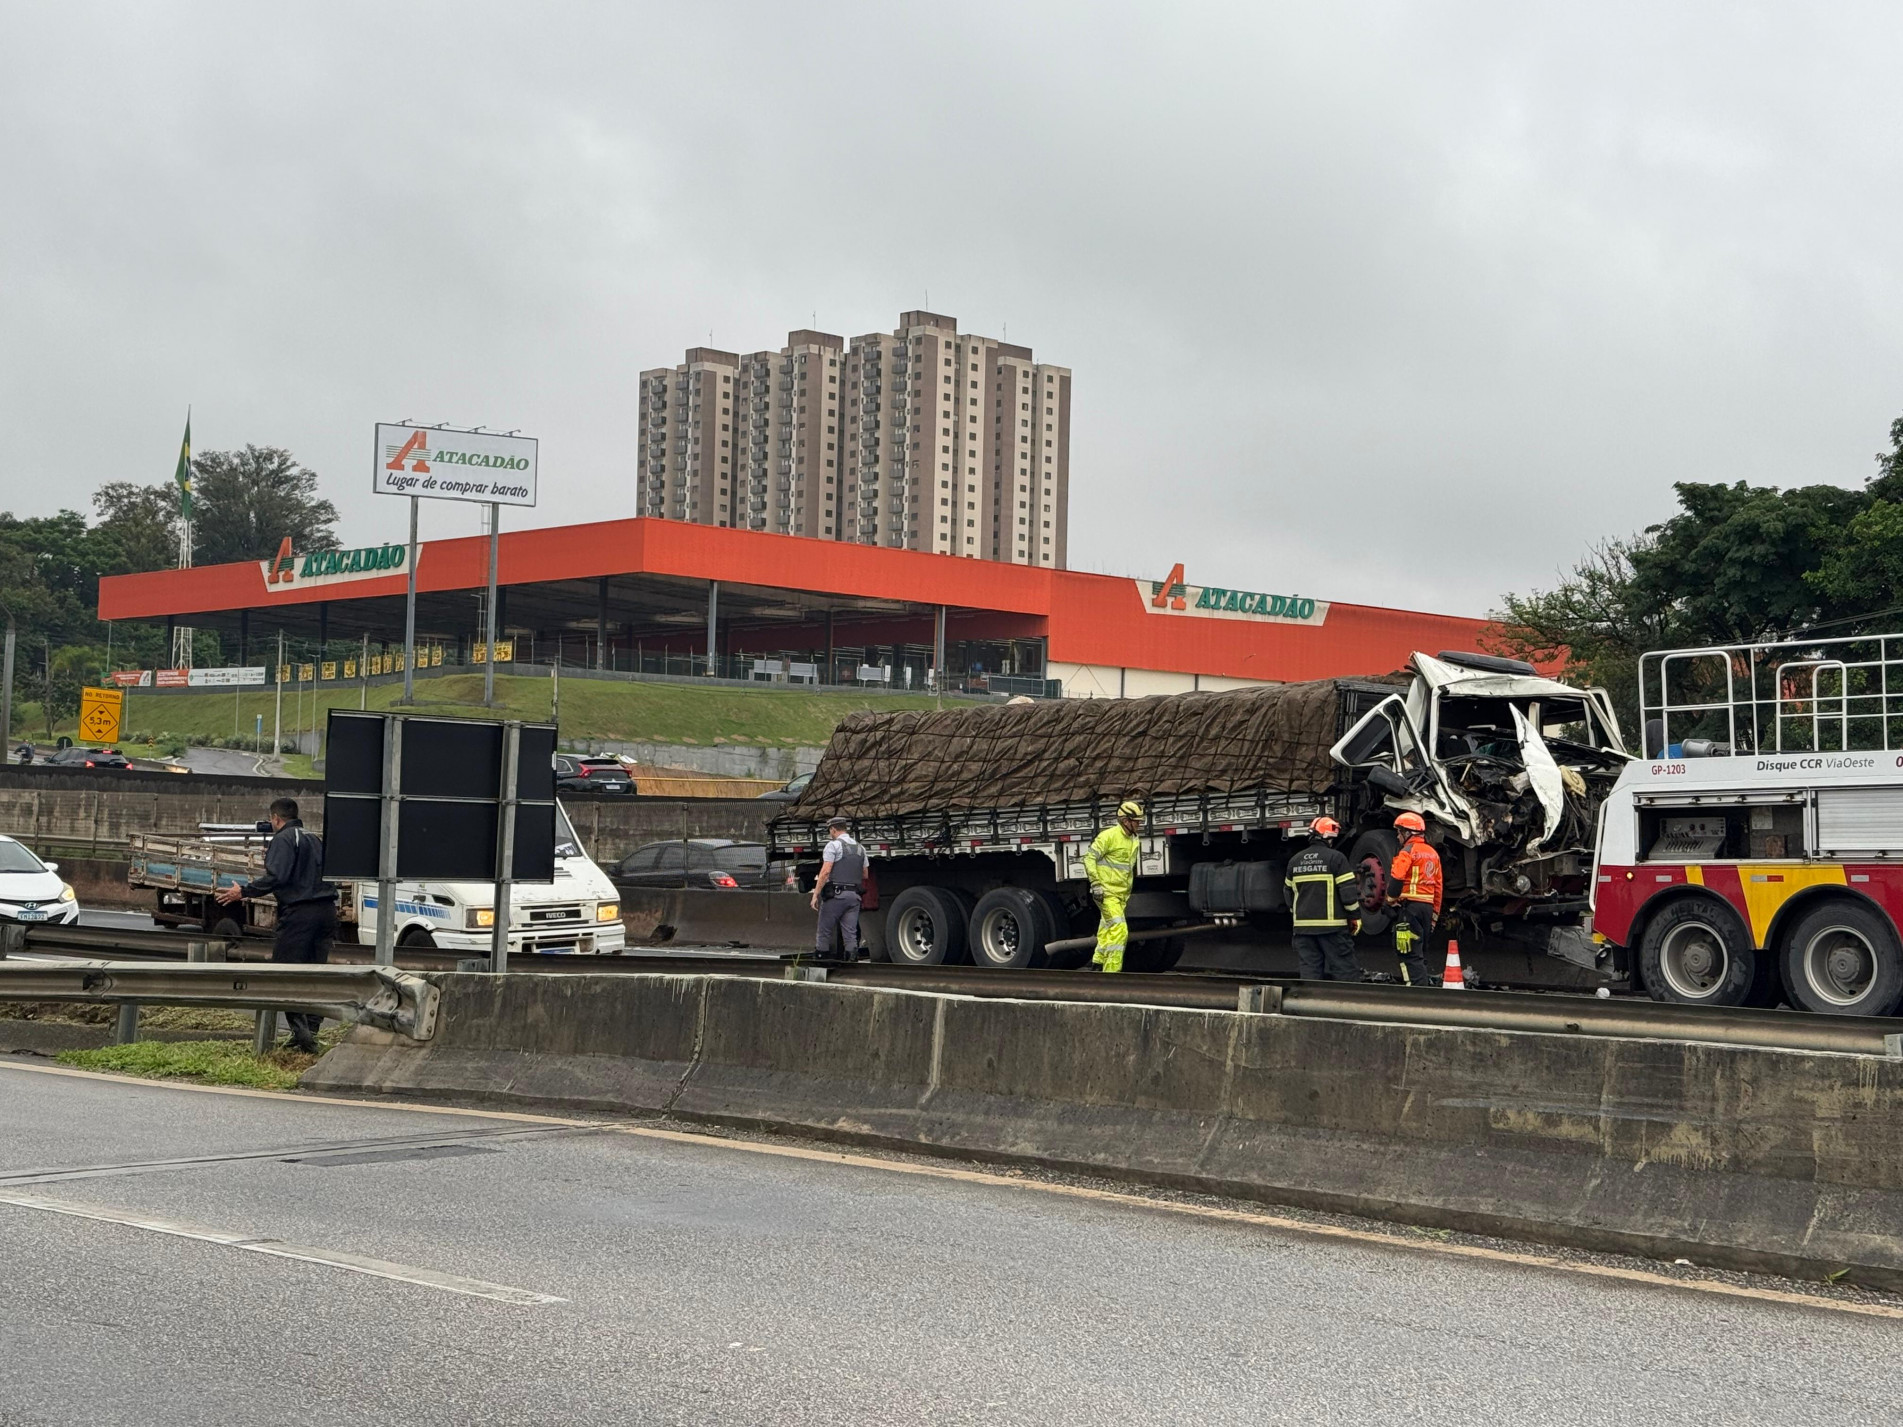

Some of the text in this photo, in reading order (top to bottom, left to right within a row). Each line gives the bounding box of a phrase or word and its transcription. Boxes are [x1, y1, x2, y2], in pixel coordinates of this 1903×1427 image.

[432, 450, 529, 471] ATACADÃO
[386, 472, 528, 498] Lugar de comprar barato
[300, 542, 406, 578] ATACADÃO
[1195, 587, 1315, 619] ATACADÃO
[1651, 764, 1686, 776] GP-1203
[1757, 761, 1797, 773] Disque
[1800, 758, 1823, 769] CCR
[1826, 757, 1875, 769] ViaOeste
[1293, 865, 1328, 873] RESGATE
[545, 911, 567, 919] IVECO
